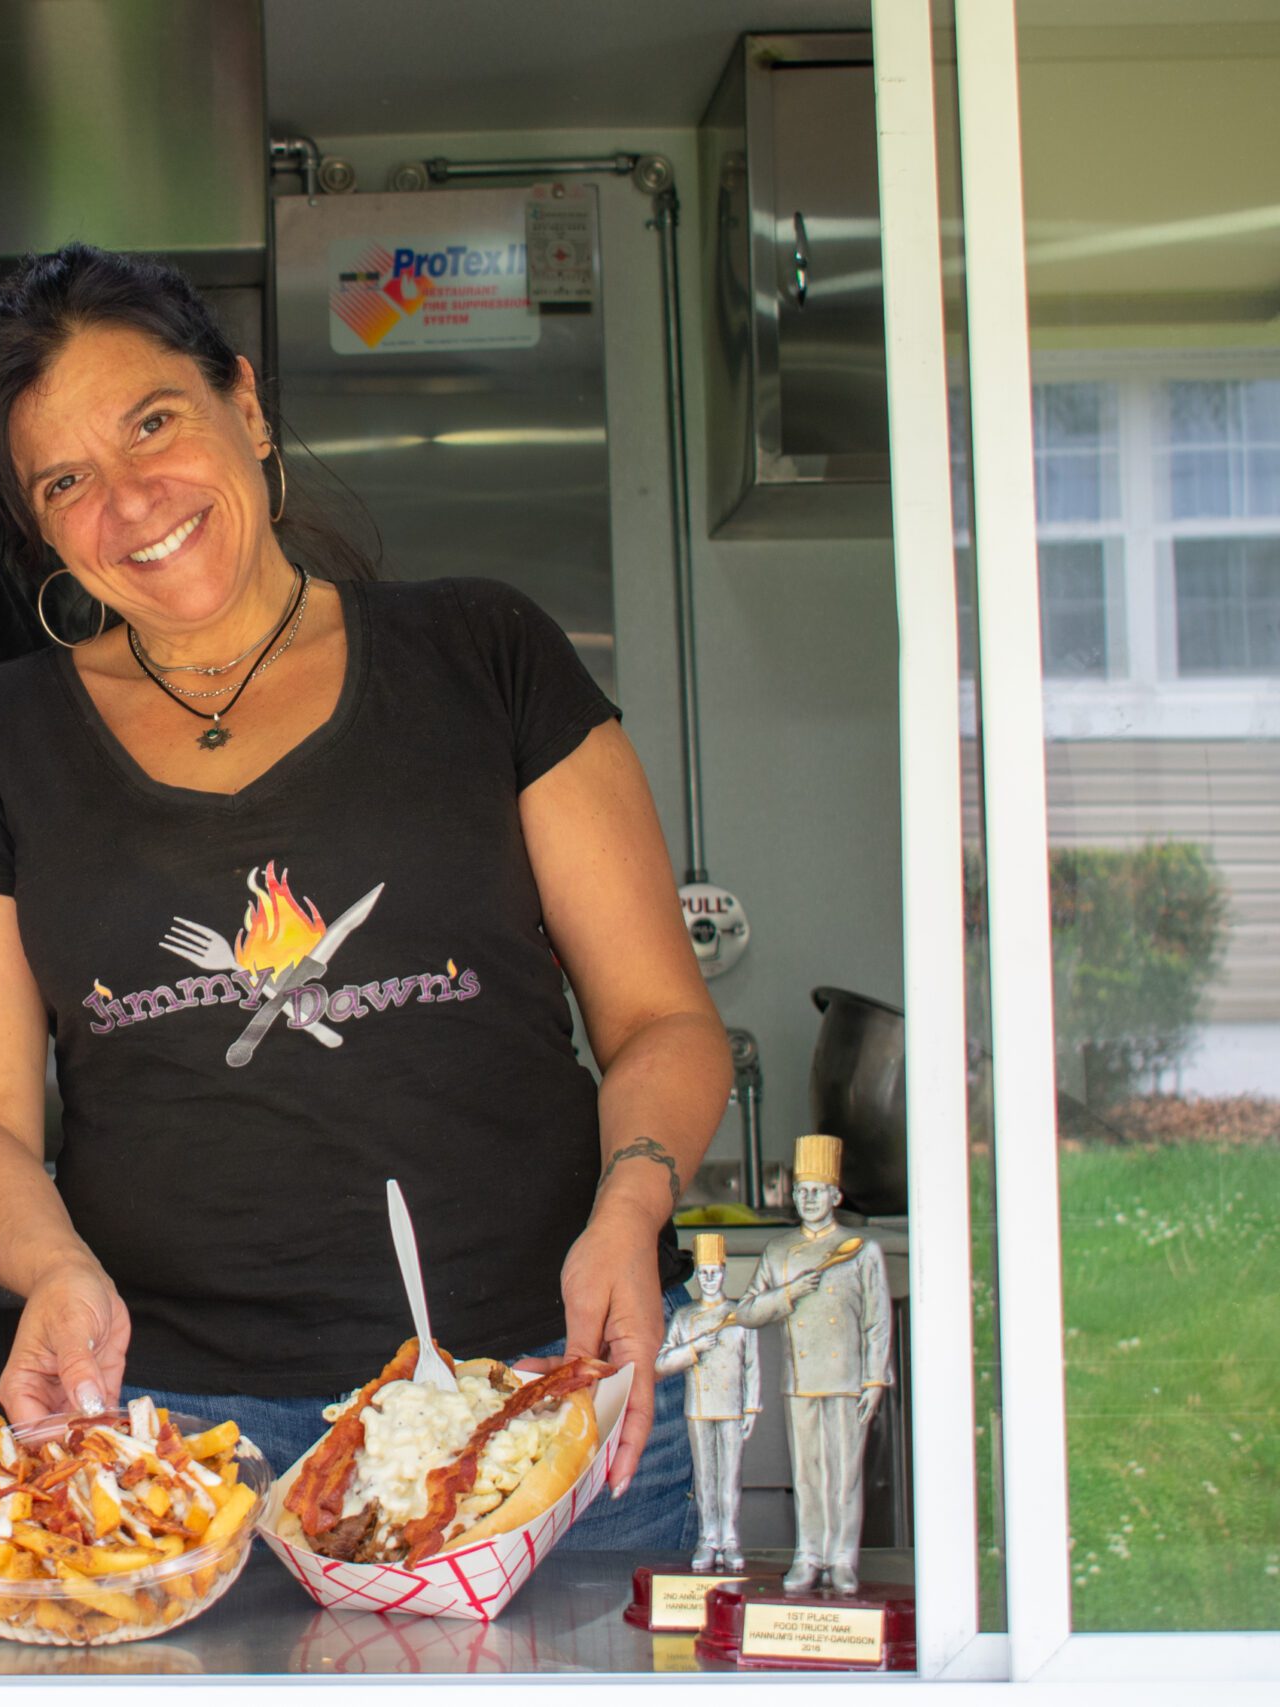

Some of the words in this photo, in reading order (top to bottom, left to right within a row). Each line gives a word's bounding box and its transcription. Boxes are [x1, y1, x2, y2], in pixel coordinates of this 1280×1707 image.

[393, 247, 502, 279] ProTex
[423, 284, 498, 298] RESTAURANT
[422, 299, 448, 311] FIRE
[422, 313, 470, 326] SYSTEM
[82, 967, 275, 1034] Jimmy
[285, 958, 481, 1029] Dawn's
[787, 1612, 805, 1621] 1ST
[807, 1612, 840, 1622] PLACE
[773, 1622, 798, 1631] FOOD
[800, 1622, 828, 1632] TRUCK
[831, 1624, 851, 1633] WAR
[749, 1631, 793, 1641] HANNUM'S
[795, 1633, 875, 1645] HARLEY-DAVIDSON
